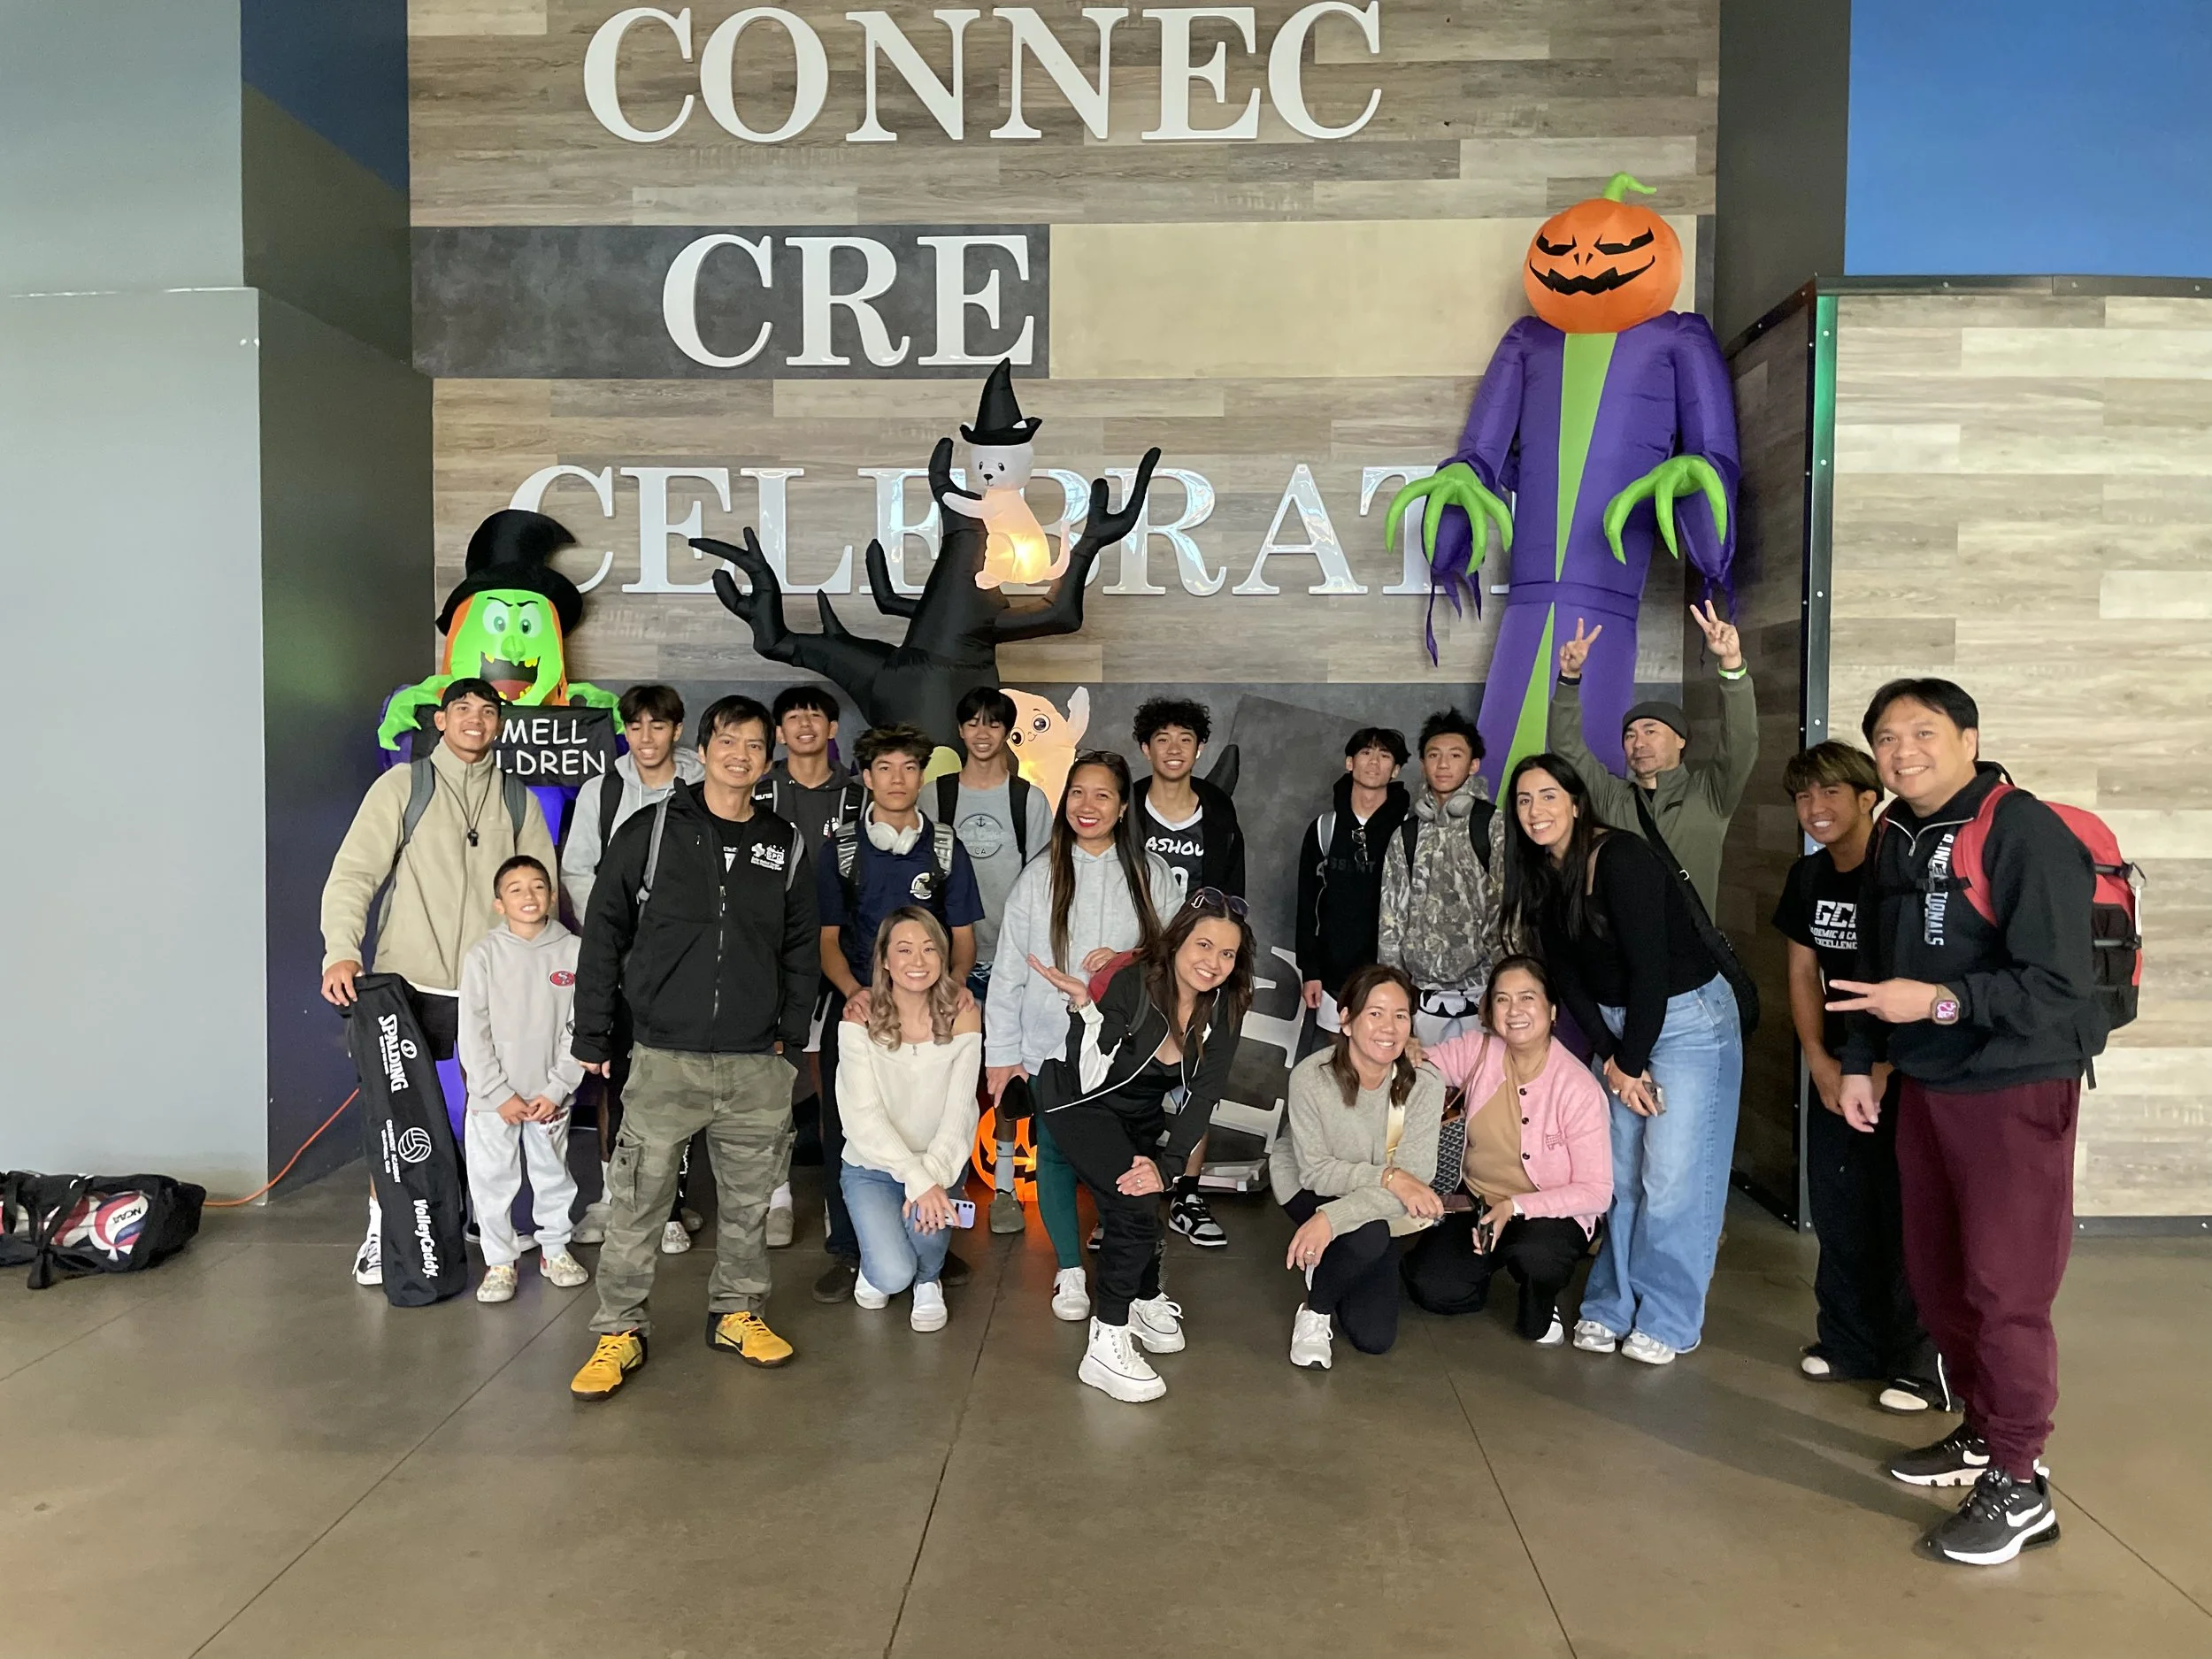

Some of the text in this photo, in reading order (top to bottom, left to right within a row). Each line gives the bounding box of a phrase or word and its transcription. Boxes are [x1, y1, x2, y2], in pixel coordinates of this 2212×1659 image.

[584, 1, 1382, 142] CONNEC
[663, 234, 1034, 367] CRE
[508, 465, 1517, 595] CELERAT
[495, 718, 588, 745] MELL
[496, 749, 606, 775] LDREN
[1927, 891, 1949, 946] TIONALS
[378, 1014, 409, 1094] SPALDING
